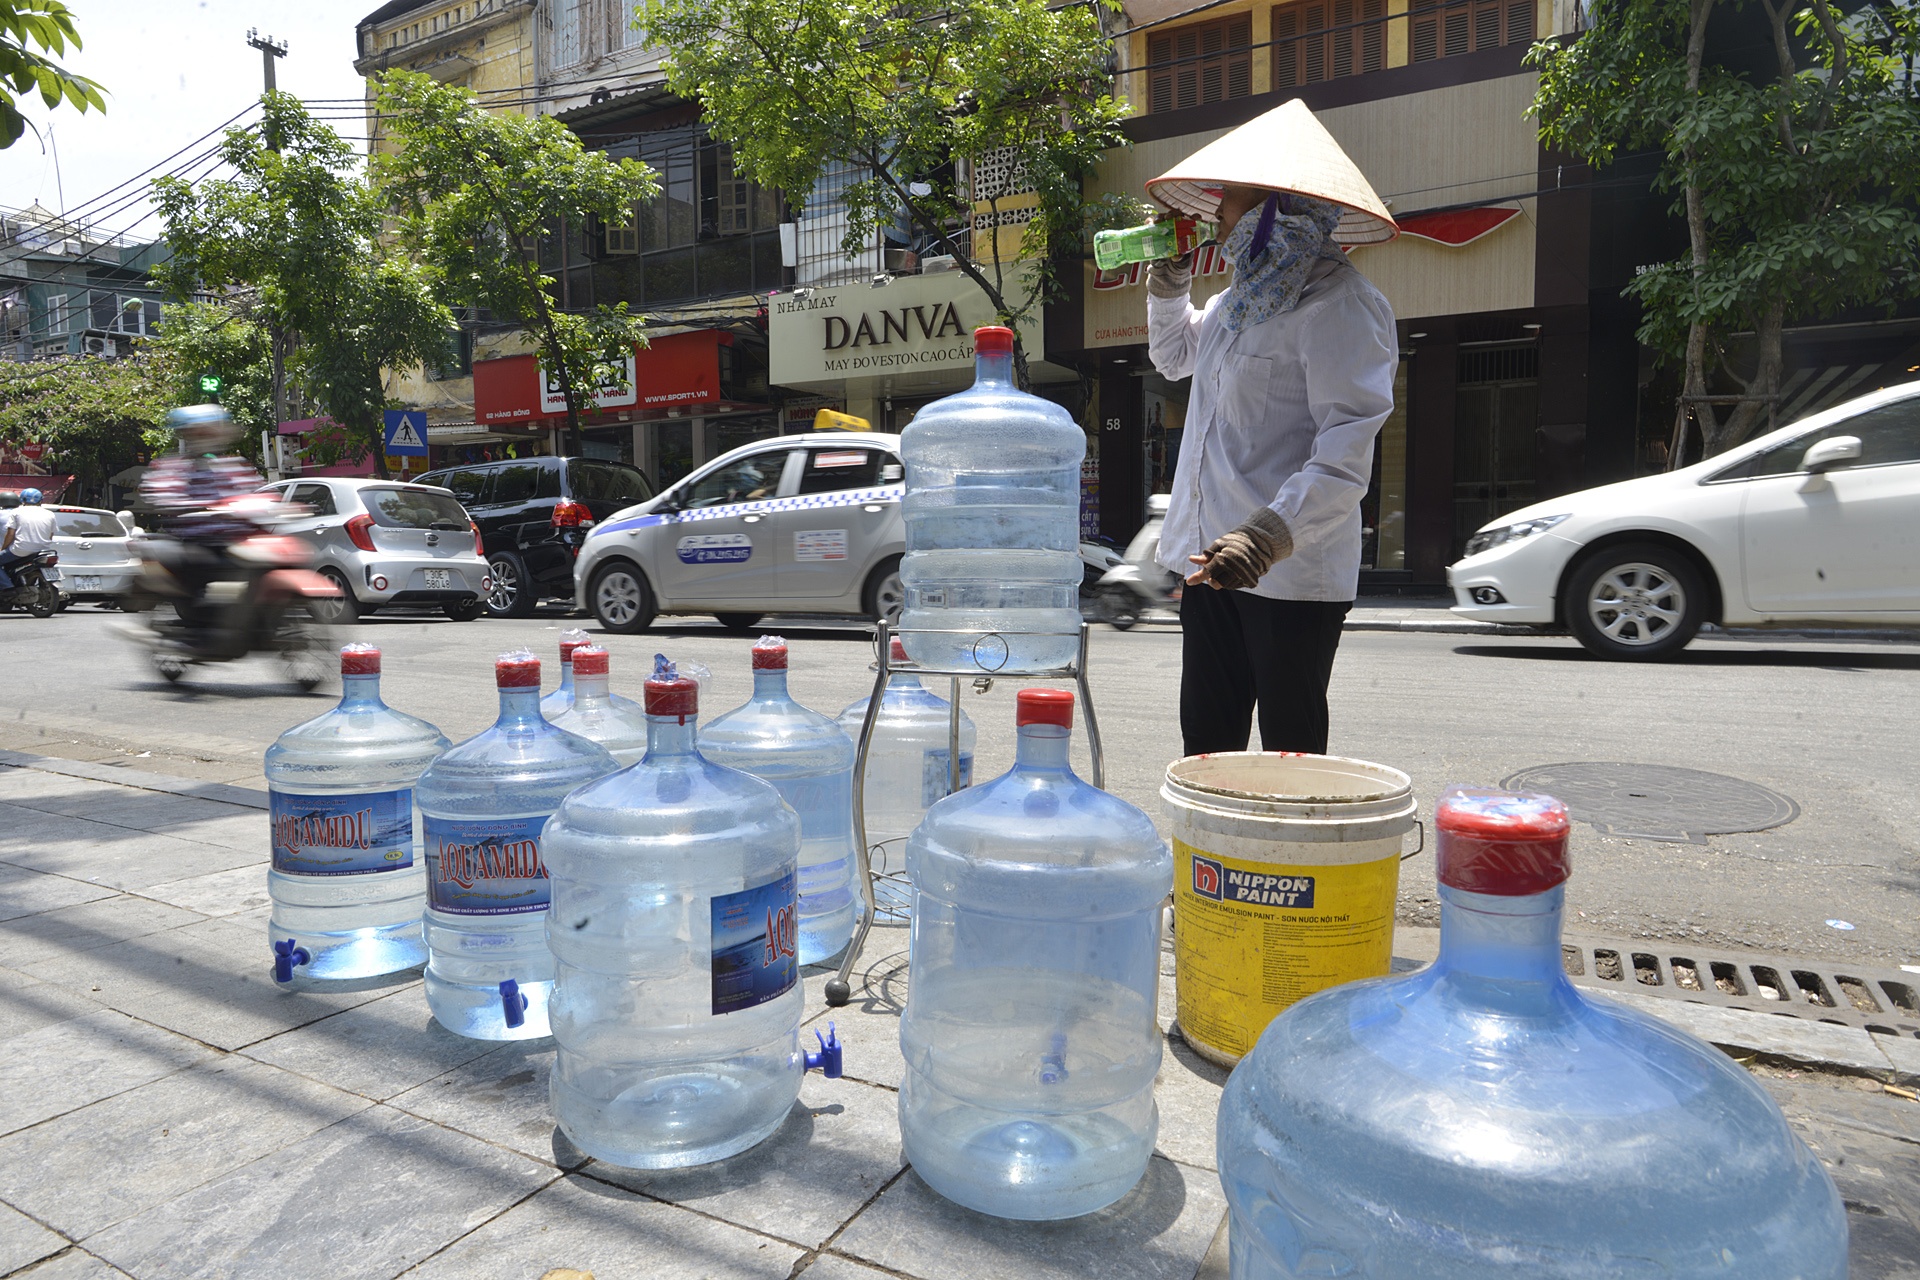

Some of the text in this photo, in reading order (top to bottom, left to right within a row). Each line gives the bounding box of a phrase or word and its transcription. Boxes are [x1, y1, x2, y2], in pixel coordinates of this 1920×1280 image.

[1635, 264, 1647, 276] 56
[808, 295, 837, 310] MAY
[822, 301, 967, 350] DANVA
[1112, 325, 1133, 338] HÀNG
[824, 341, 975, 372] MAY ĐO VESTON CAO CẤP
[201, 377, 218, 392] 32
[547, 394, 567, 403] HÀN
[644, 390, 708, 404] WWW.SPORT1.VN
[1106, 418, 1121, 431] 58
[275, 807, 372, 854] AQUAMIDU
[1228, 871, 1308, 892] NIPPON
[1236, 886, 1299, 906] PAINT
[1194, 896, 1219, 910] INTERIOR
[1219, 904, 1253, 918] EMULSION
[1253, 912, 1275, 921] PAINT
[1281, 915, 1297, 923] SƠN
[1333, 913, 1350, 923] THẤT
